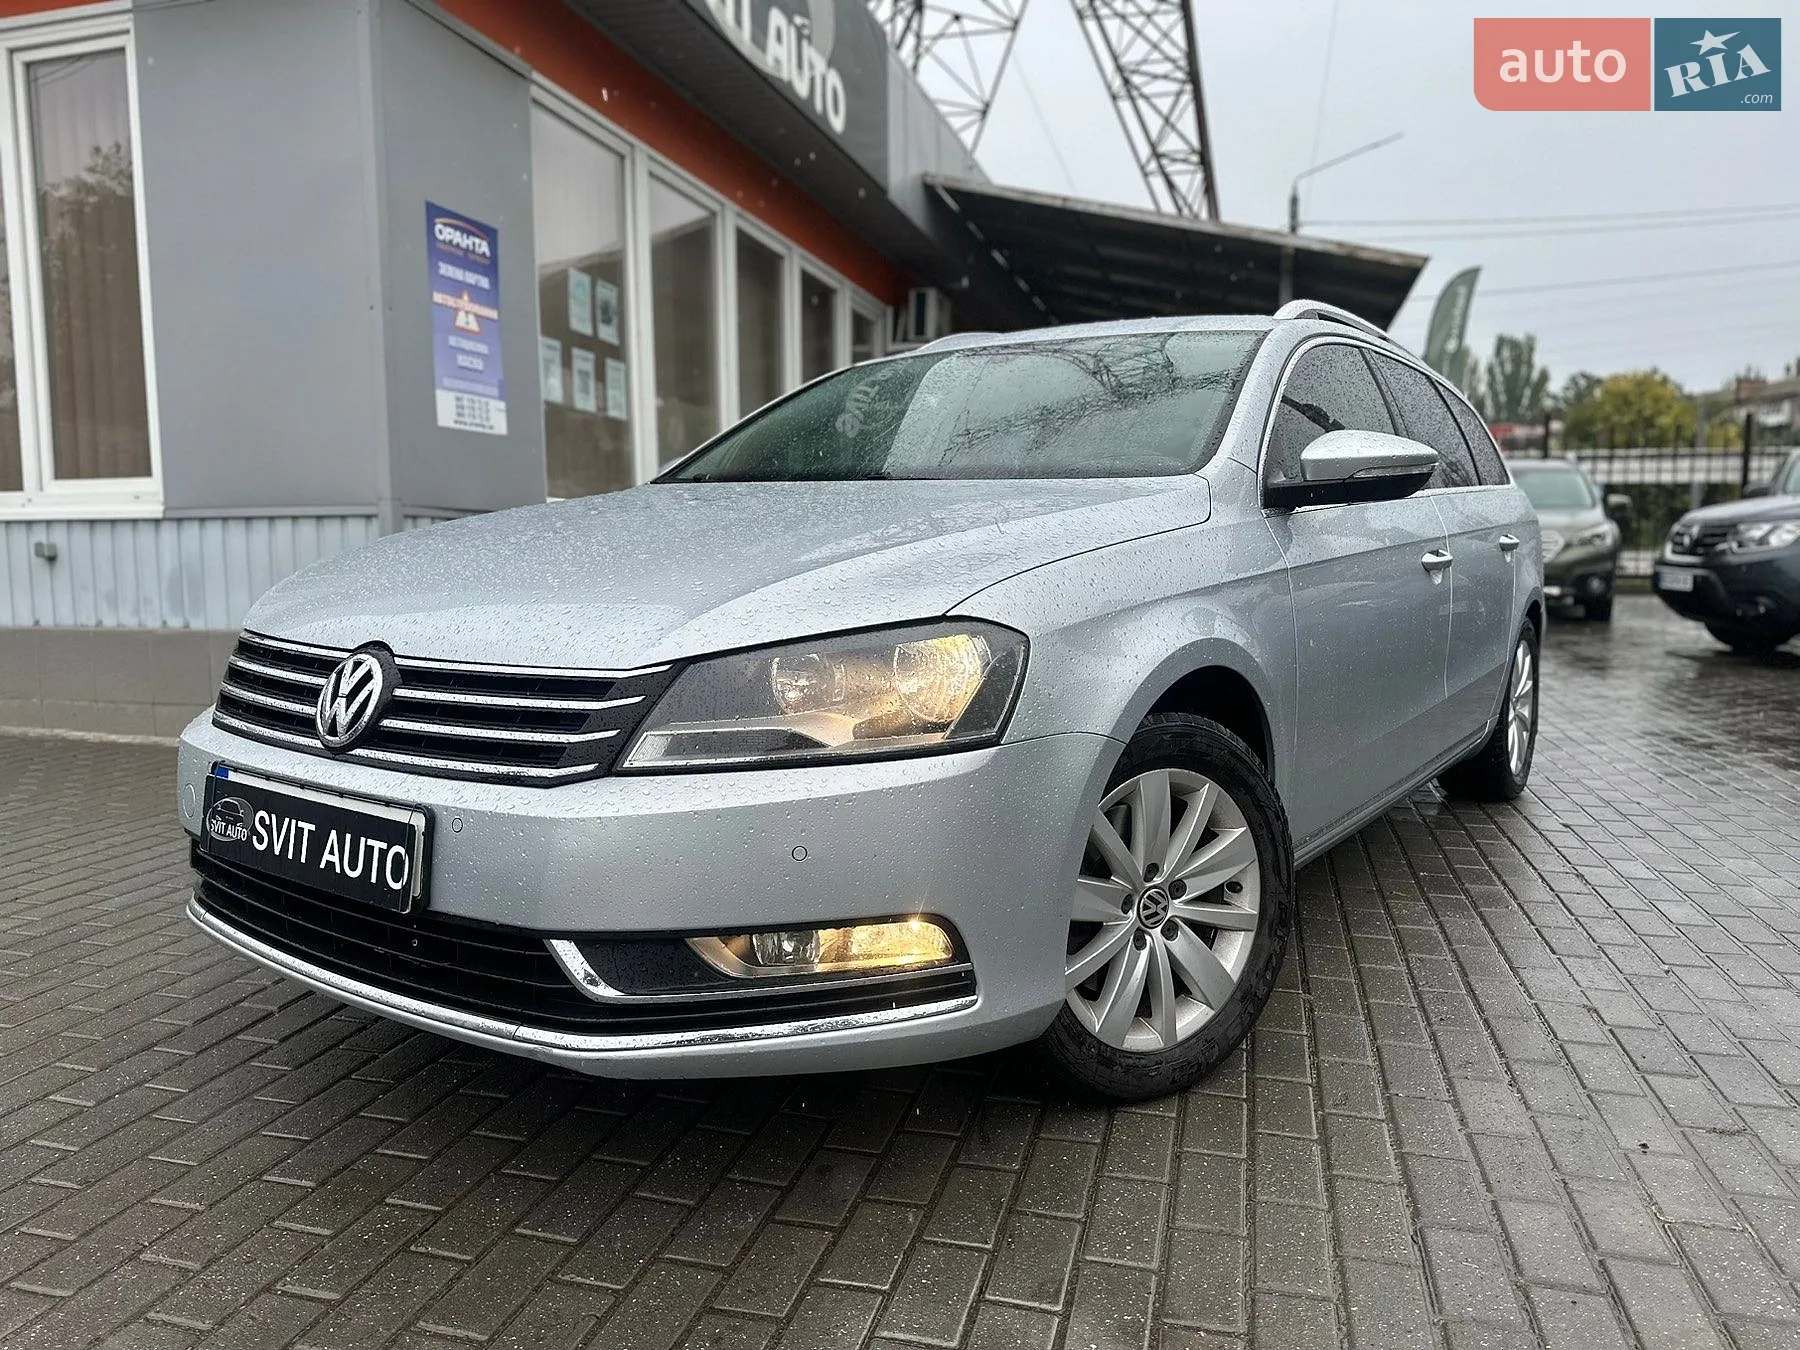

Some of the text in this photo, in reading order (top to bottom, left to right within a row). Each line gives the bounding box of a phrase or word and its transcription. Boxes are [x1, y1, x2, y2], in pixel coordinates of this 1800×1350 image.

[765, 6, 846, 135] AUTO
[434, 223, 491, 258] ОРАНТА
[210, 819, 248, 841] SVIT AUTO
[252, 810, 409, 890] SVIT AUTO
